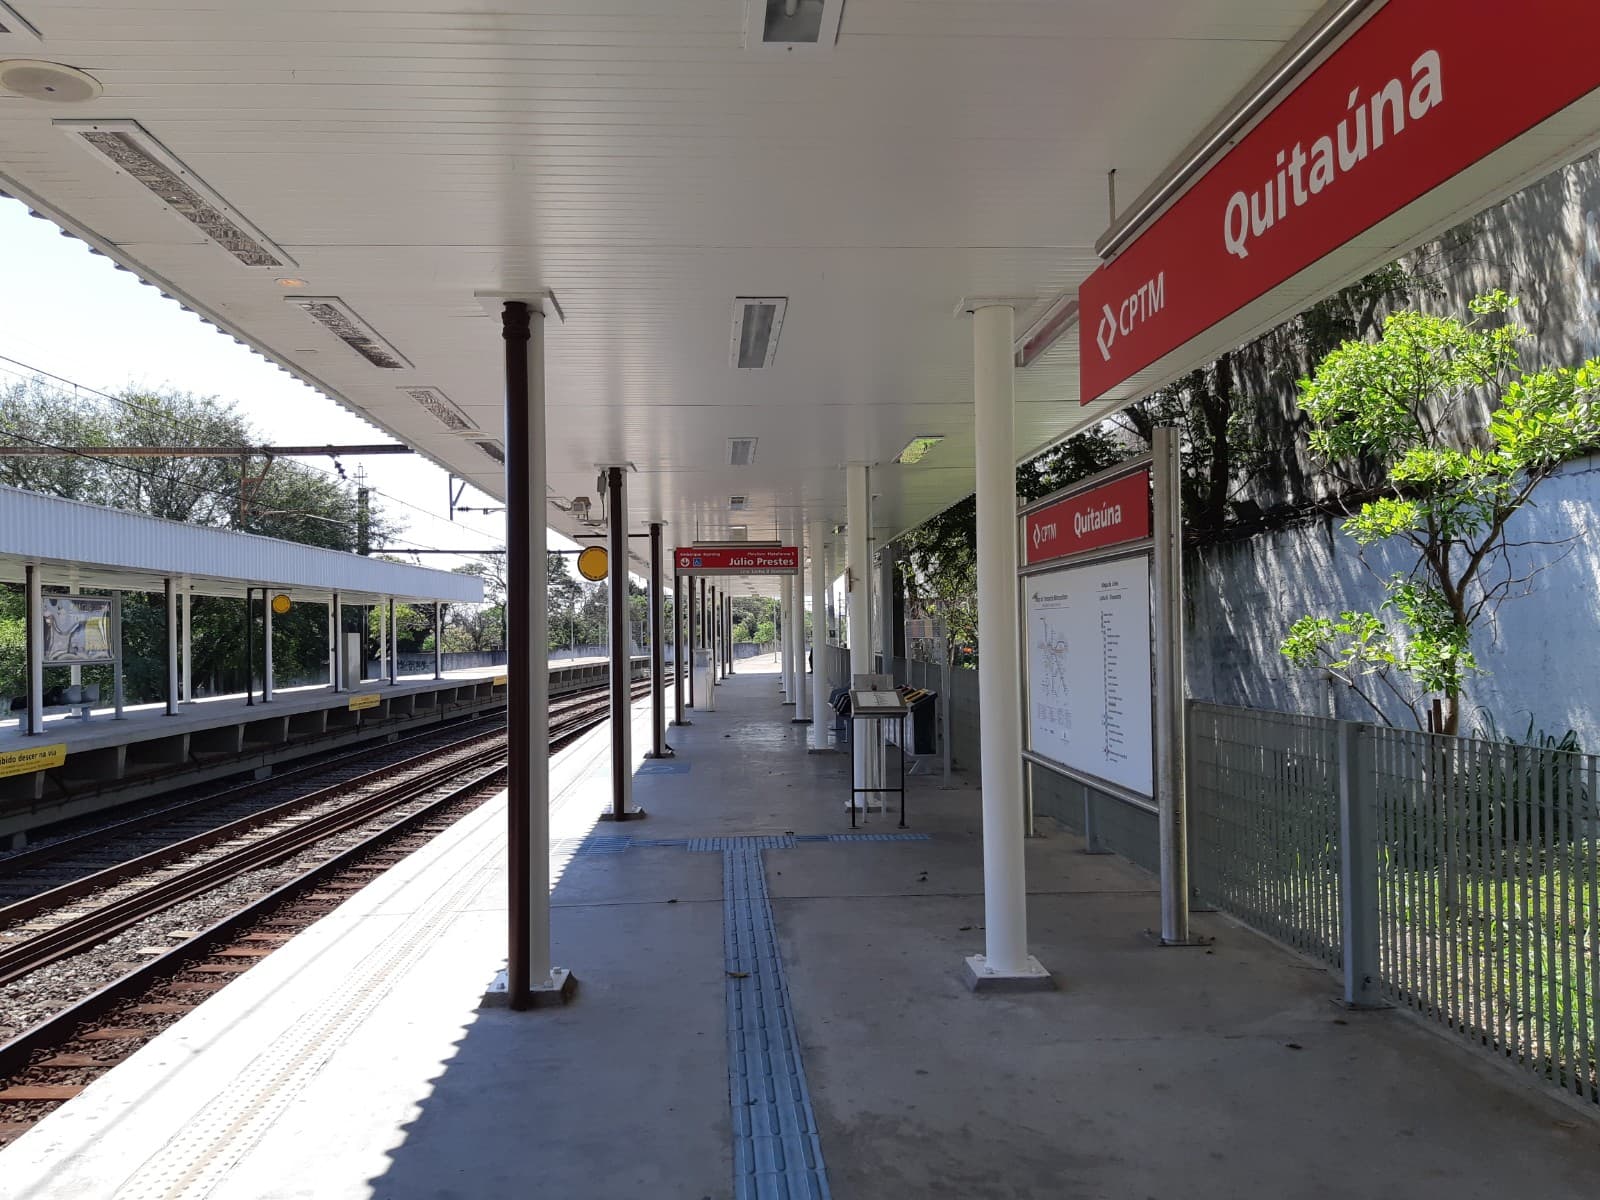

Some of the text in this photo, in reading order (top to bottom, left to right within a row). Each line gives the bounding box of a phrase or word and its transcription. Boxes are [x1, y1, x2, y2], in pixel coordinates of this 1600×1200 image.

[1223, 49, 1444, 260] Quitaúna
[1119, 271, 1165, 337] CPTM
[1040, 523, 1057, 542] CPTM
[1073, 501, 1122, 538] Quitaúna
[728, 557, 794, 566] Júlio Prestes
[18, 753, 38, 761] descer
